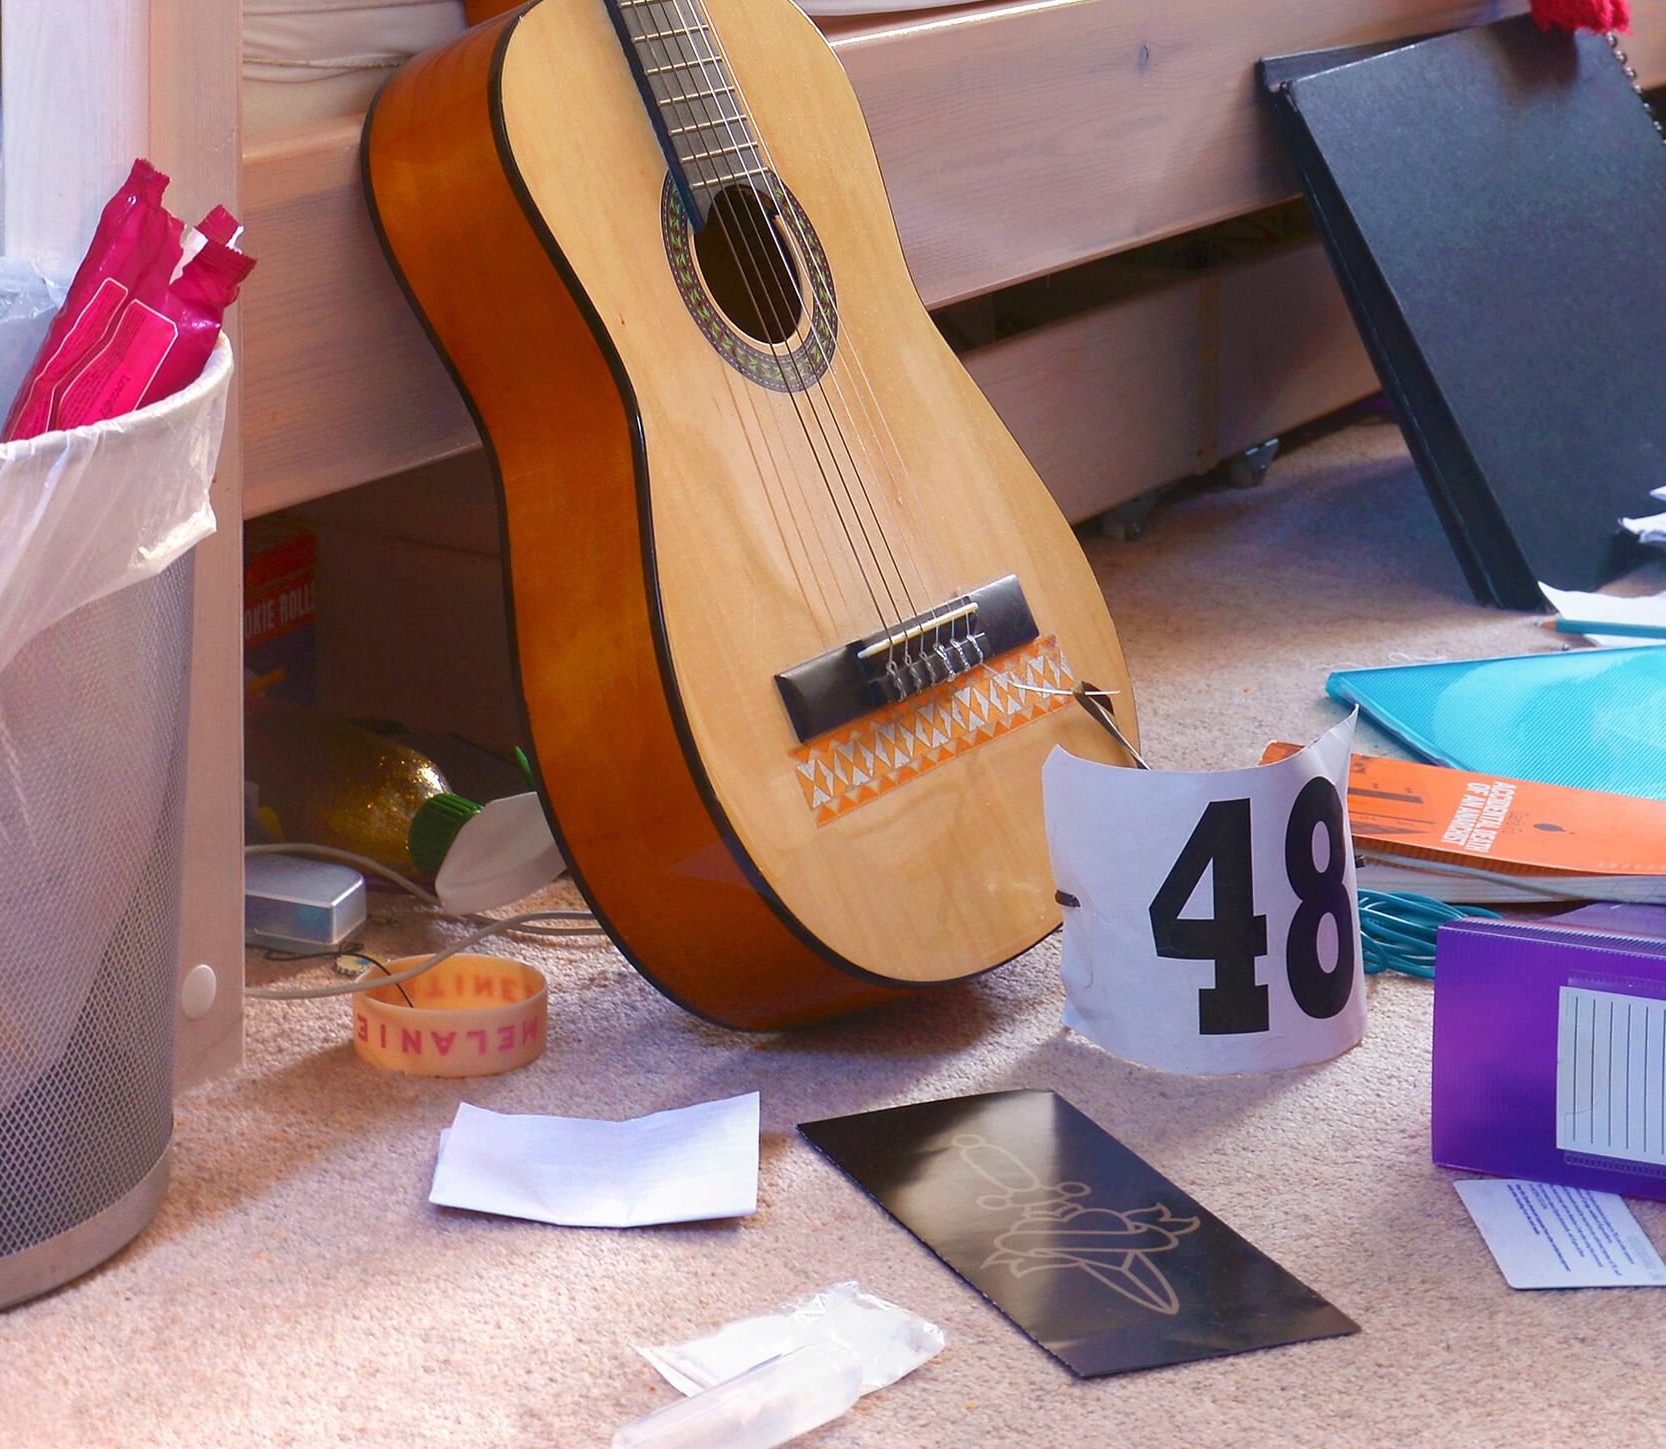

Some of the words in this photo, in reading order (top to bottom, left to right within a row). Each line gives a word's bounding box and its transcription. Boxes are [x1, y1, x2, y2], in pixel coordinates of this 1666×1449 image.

[1460, 794, 1487, 810] AN
[1466, 782, 1492, 797] OF
[1475, 780, 1517, 829] ACCIDENTAL
[1440, 805, 1483, 847] ANARCHIST
[1464, 828, 1499, 853] DEATH
[1146, 776, 1356, 1037] 48
[356, 1014, 540, 1060] MELANIE
